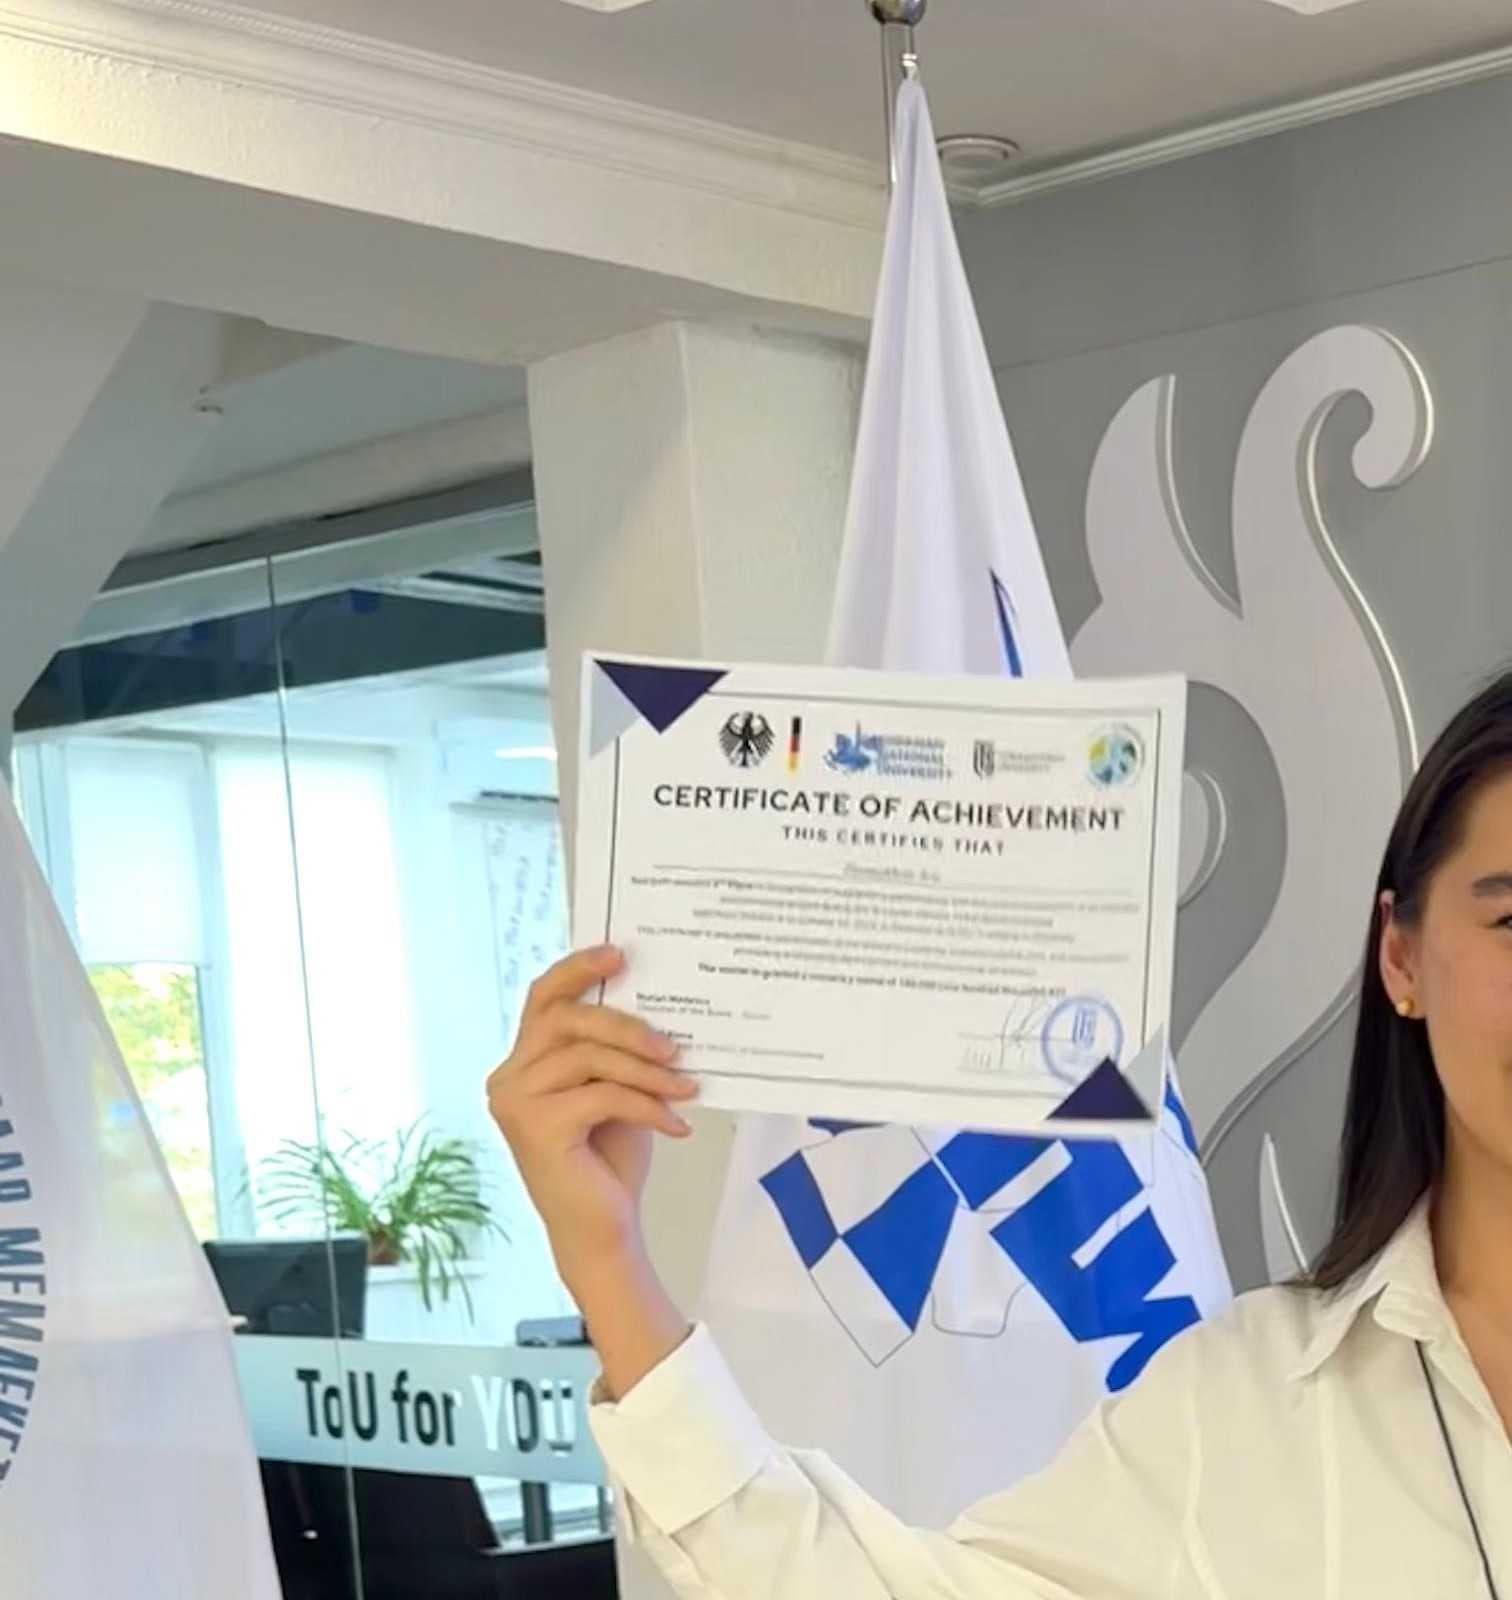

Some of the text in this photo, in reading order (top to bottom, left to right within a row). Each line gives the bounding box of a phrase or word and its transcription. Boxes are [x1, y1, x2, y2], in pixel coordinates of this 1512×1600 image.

[653, 784, 1125, 832] CERTIFICATE OF ACHIEVEMENT
[783, 825, 1004, 856] THIS CERTIFIES THAT
[296, 1368, 378, 1442] ToU
[391, 1369, 464, 1447] for
